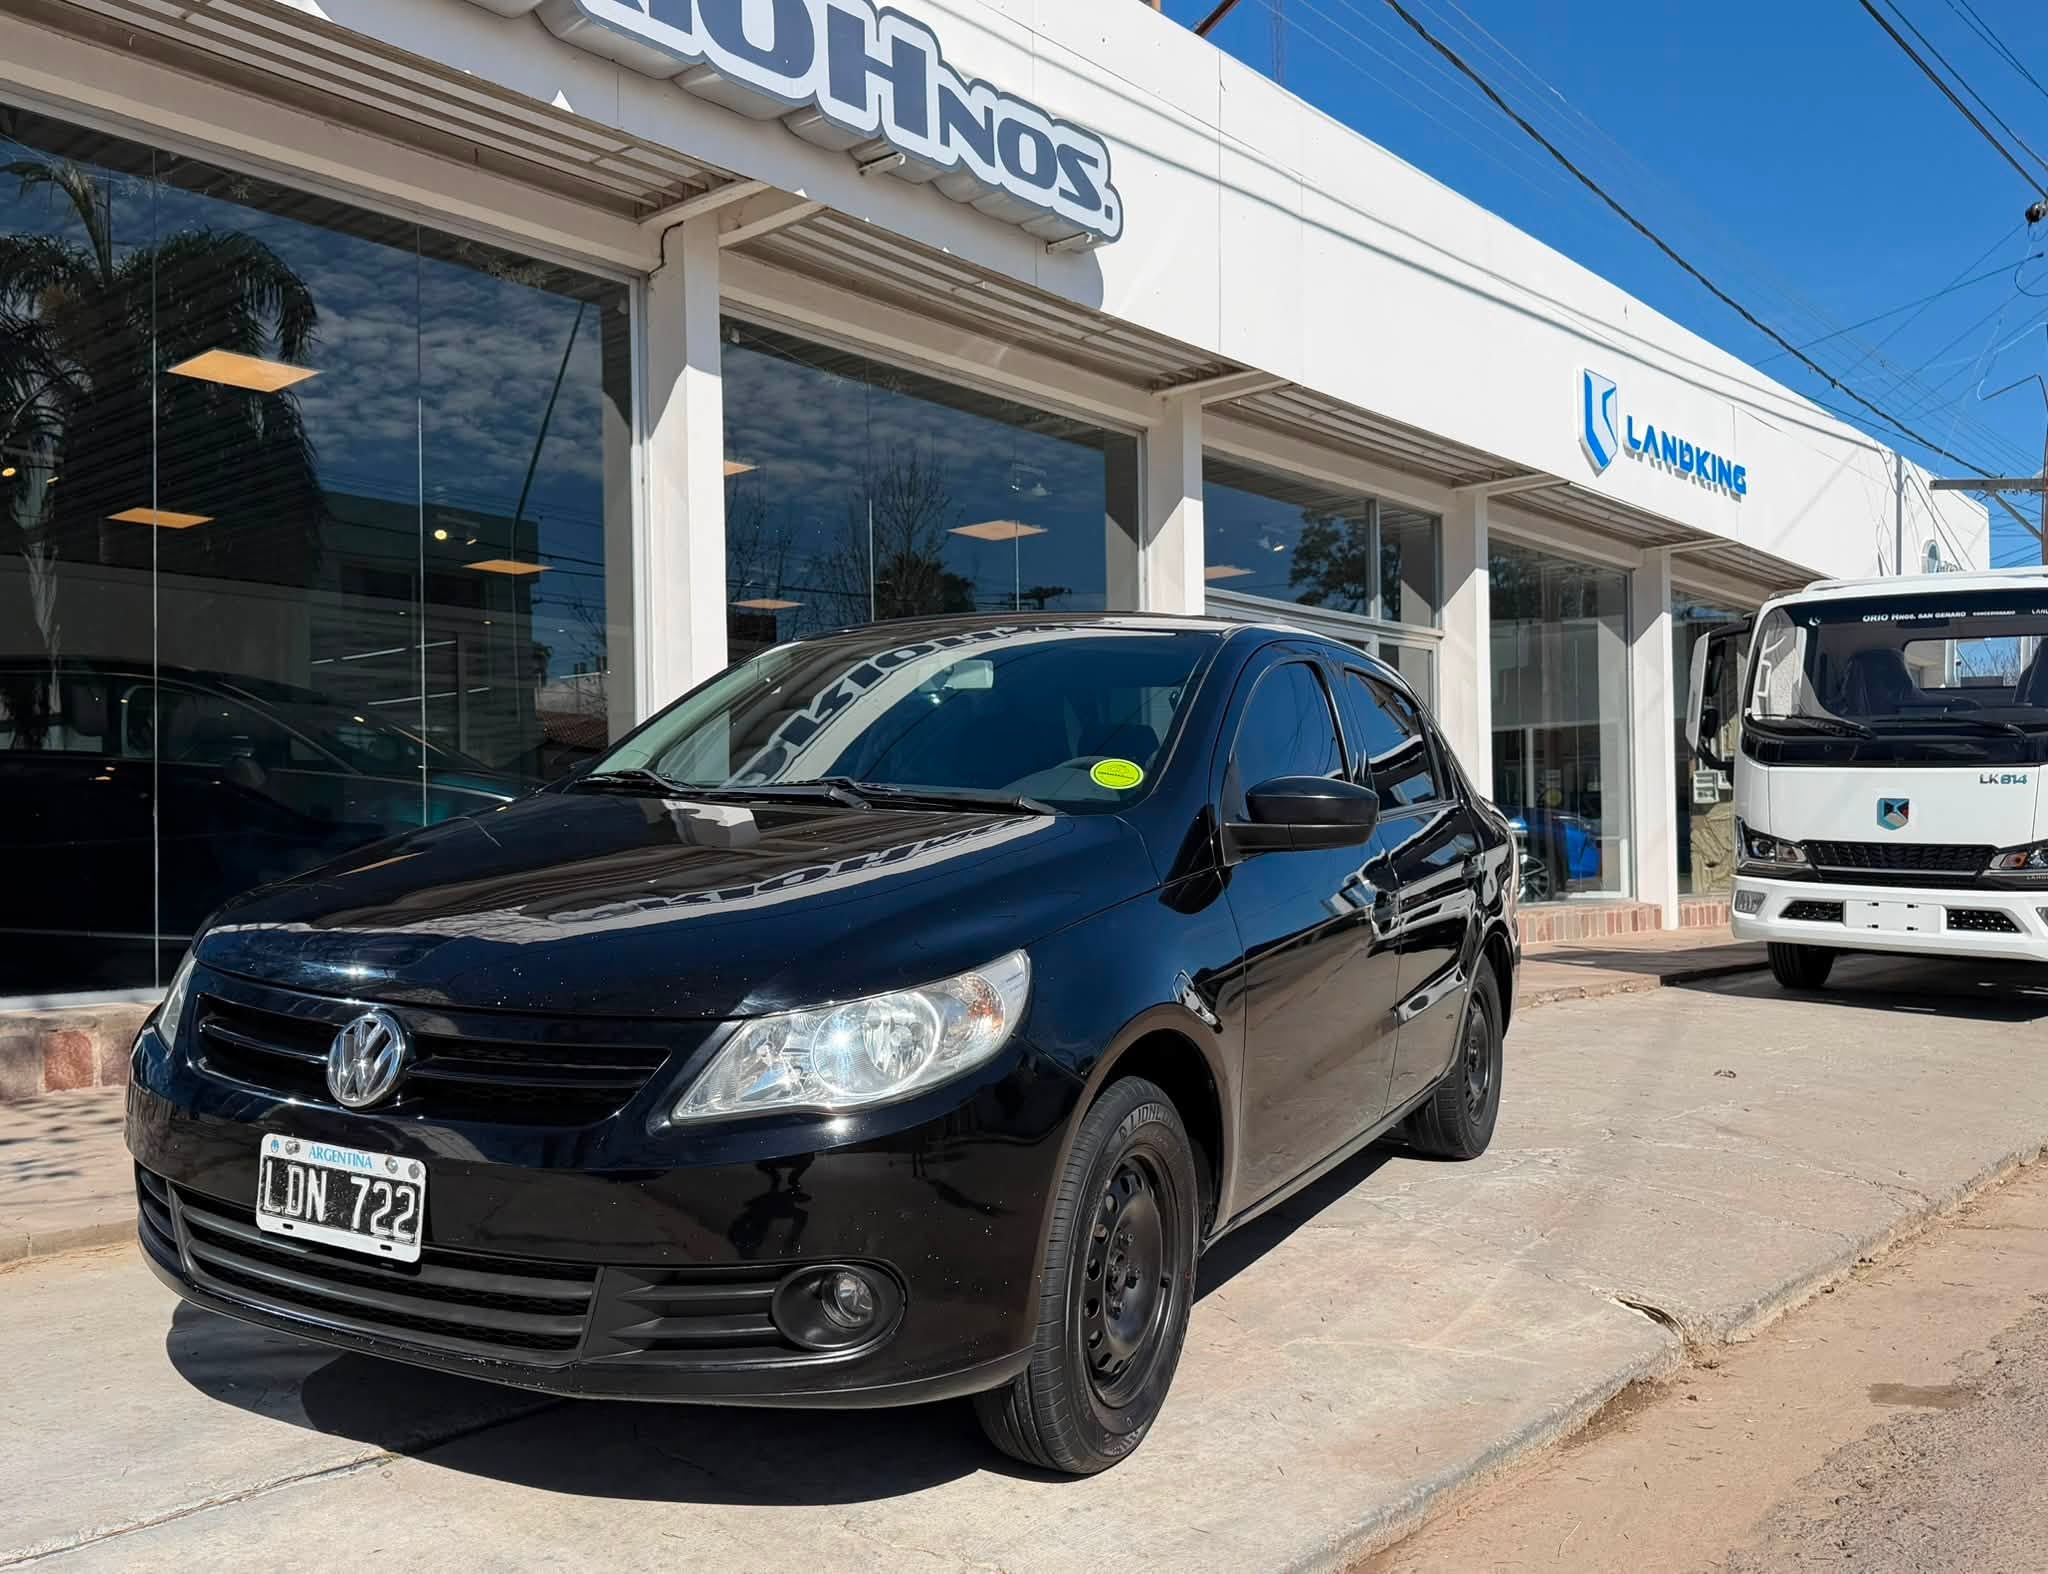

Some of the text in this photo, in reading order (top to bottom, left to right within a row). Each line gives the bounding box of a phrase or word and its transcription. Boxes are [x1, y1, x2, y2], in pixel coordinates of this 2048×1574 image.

[1627, 415, 1746, 495] LANDKING
[308, 1145, 373, 1169] ARGENTINA
[263, 1159, 416, 1244] LDN 722
